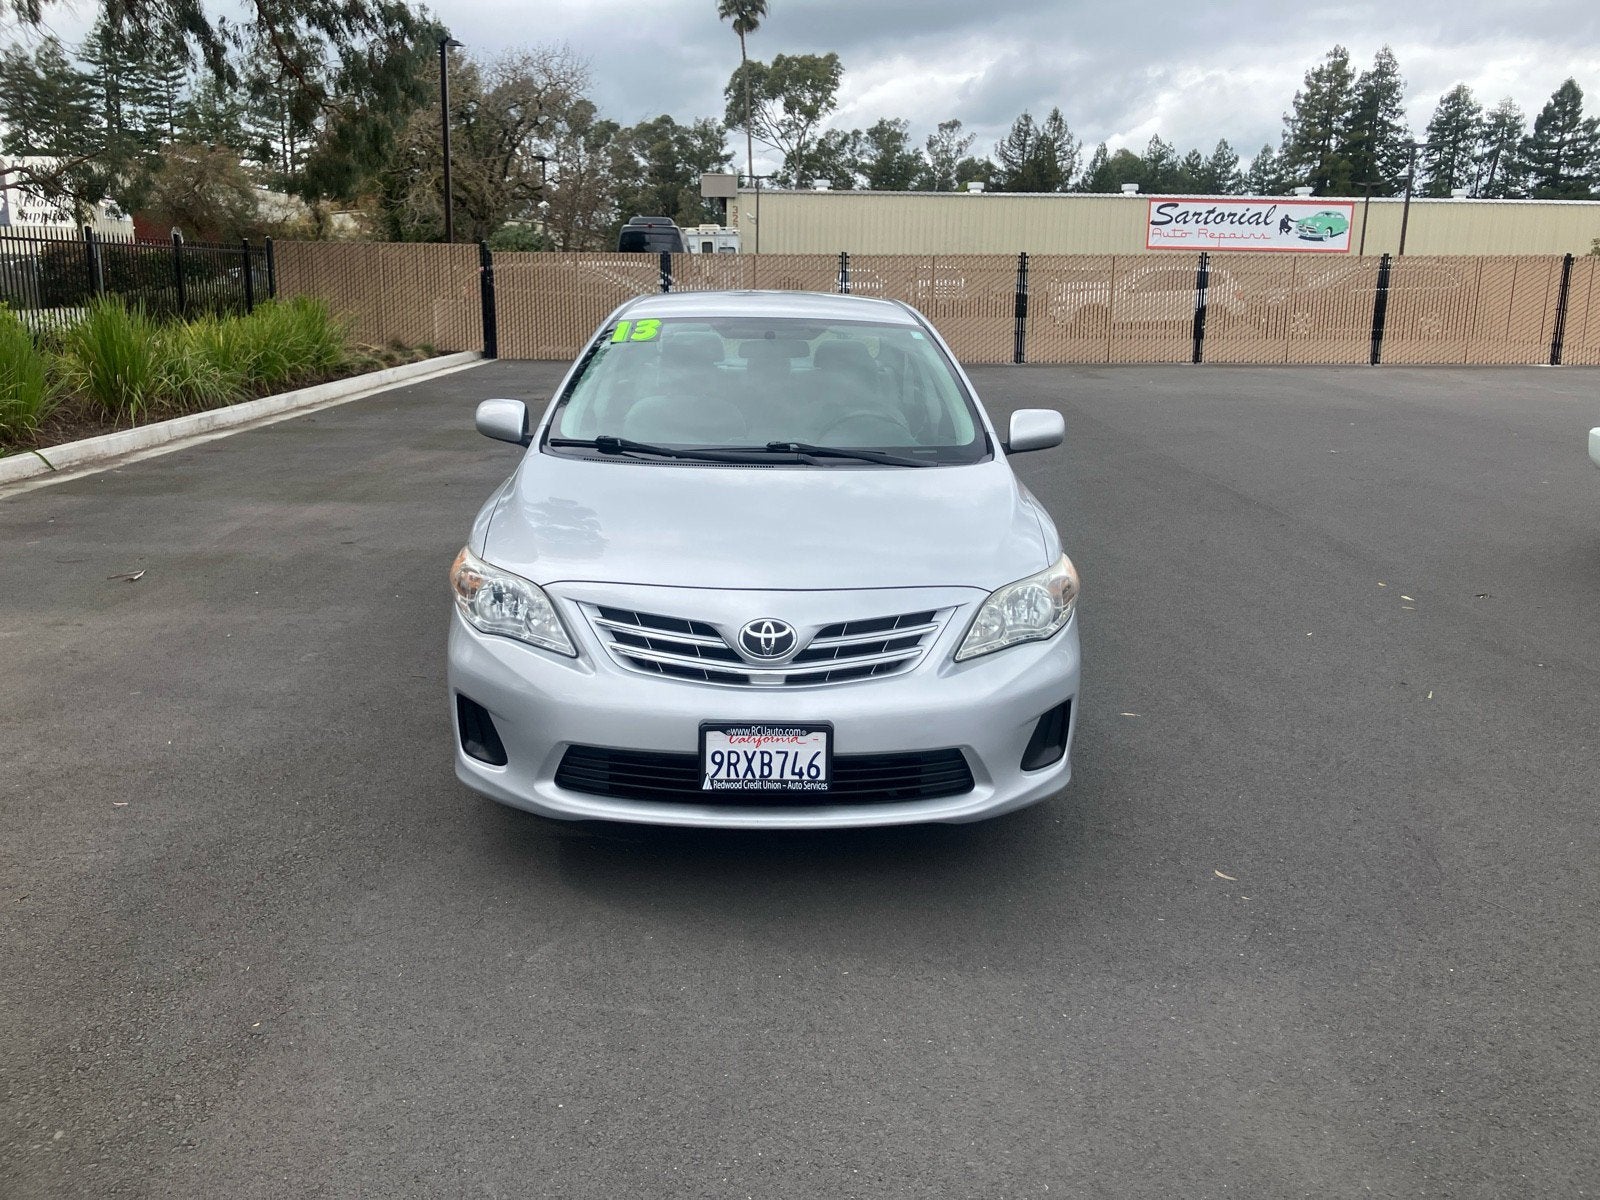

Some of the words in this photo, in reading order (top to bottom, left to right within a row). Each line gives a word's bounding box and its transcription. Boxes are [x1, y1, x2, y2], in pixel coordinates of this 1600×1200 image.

[1150, 202, 1277, 226] Sartorial
[1152, 228, 1192, 238] Auto
[1198, 228, 1271, 247] Repairs
[611, 319, 661, 342] 13
[730, 726, 801, 737] www.RCUauto.com
[729, 735, 807, 749] California
[710, 750, 821, 779] 9RXB746
[713, 780, 743, 789] Redwood
[743, 780, 762, 789] Credit
[762, 781, 782, 789] Union
[787, 781, 803, 790] Auto
[803, 781, 828, 790] Services
